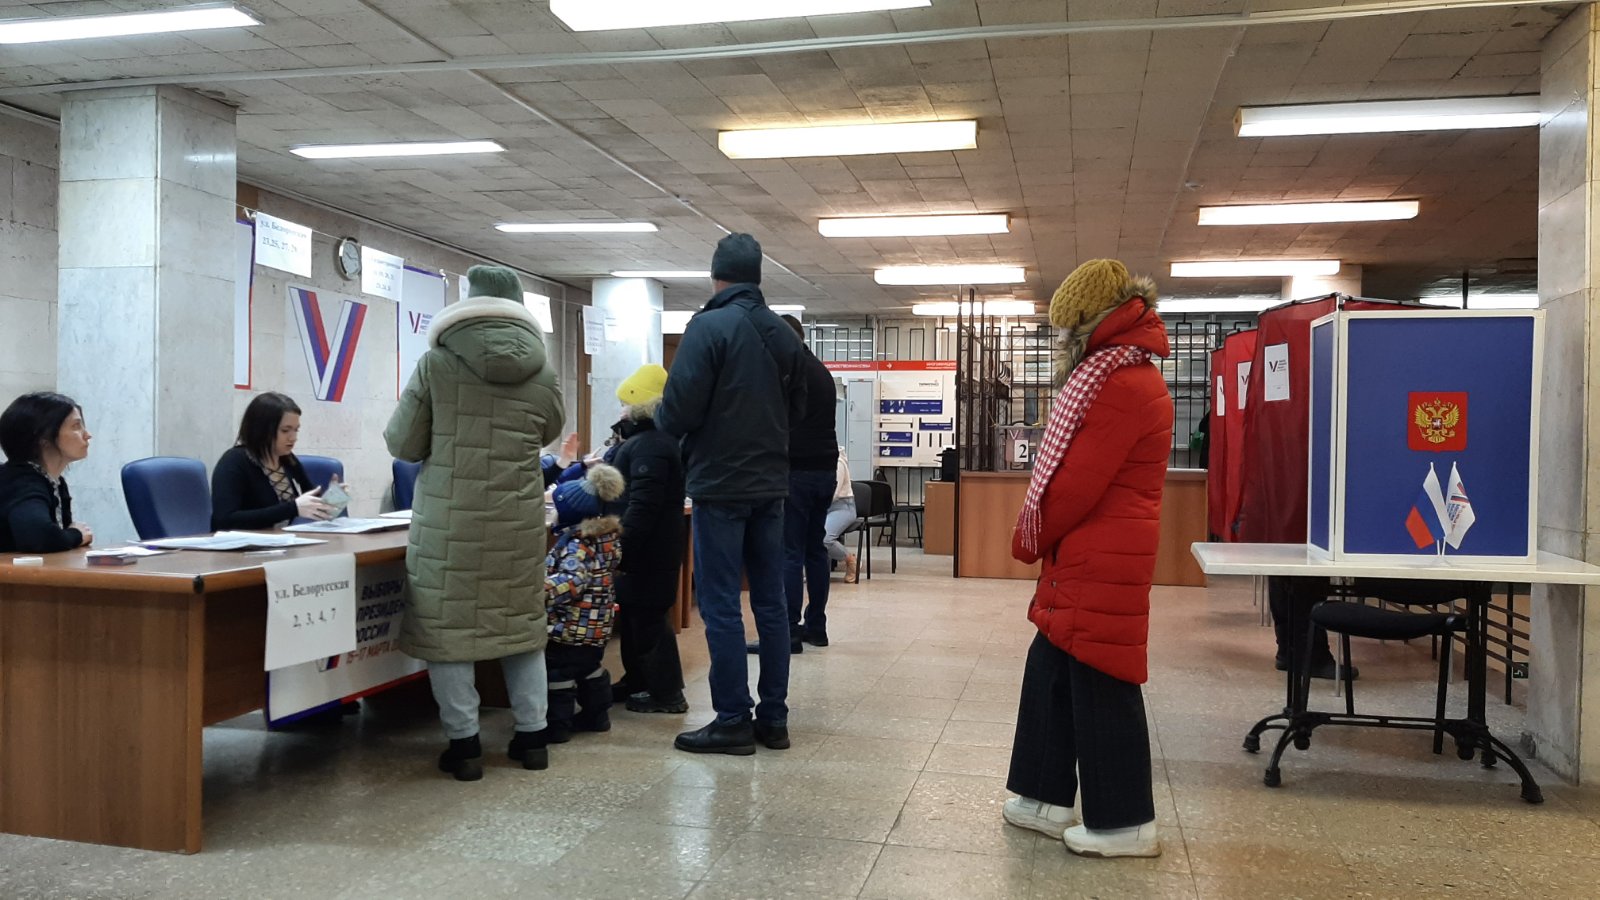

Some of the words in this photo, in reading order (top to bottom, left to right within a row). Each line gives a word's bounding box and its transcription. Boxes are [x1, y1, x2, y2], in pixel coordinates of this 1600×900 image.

[1019, 443, 1027, 459] 2
[275, 588, 290, 604] ул.
[292, 580, 350, 598] Белорусская
[293, 614, 302, 628] 2,
[306, 612, 315, 626] 3,
[331, 607, 337, 621] 7
[356, 622, 391, 643] ОССИИ
